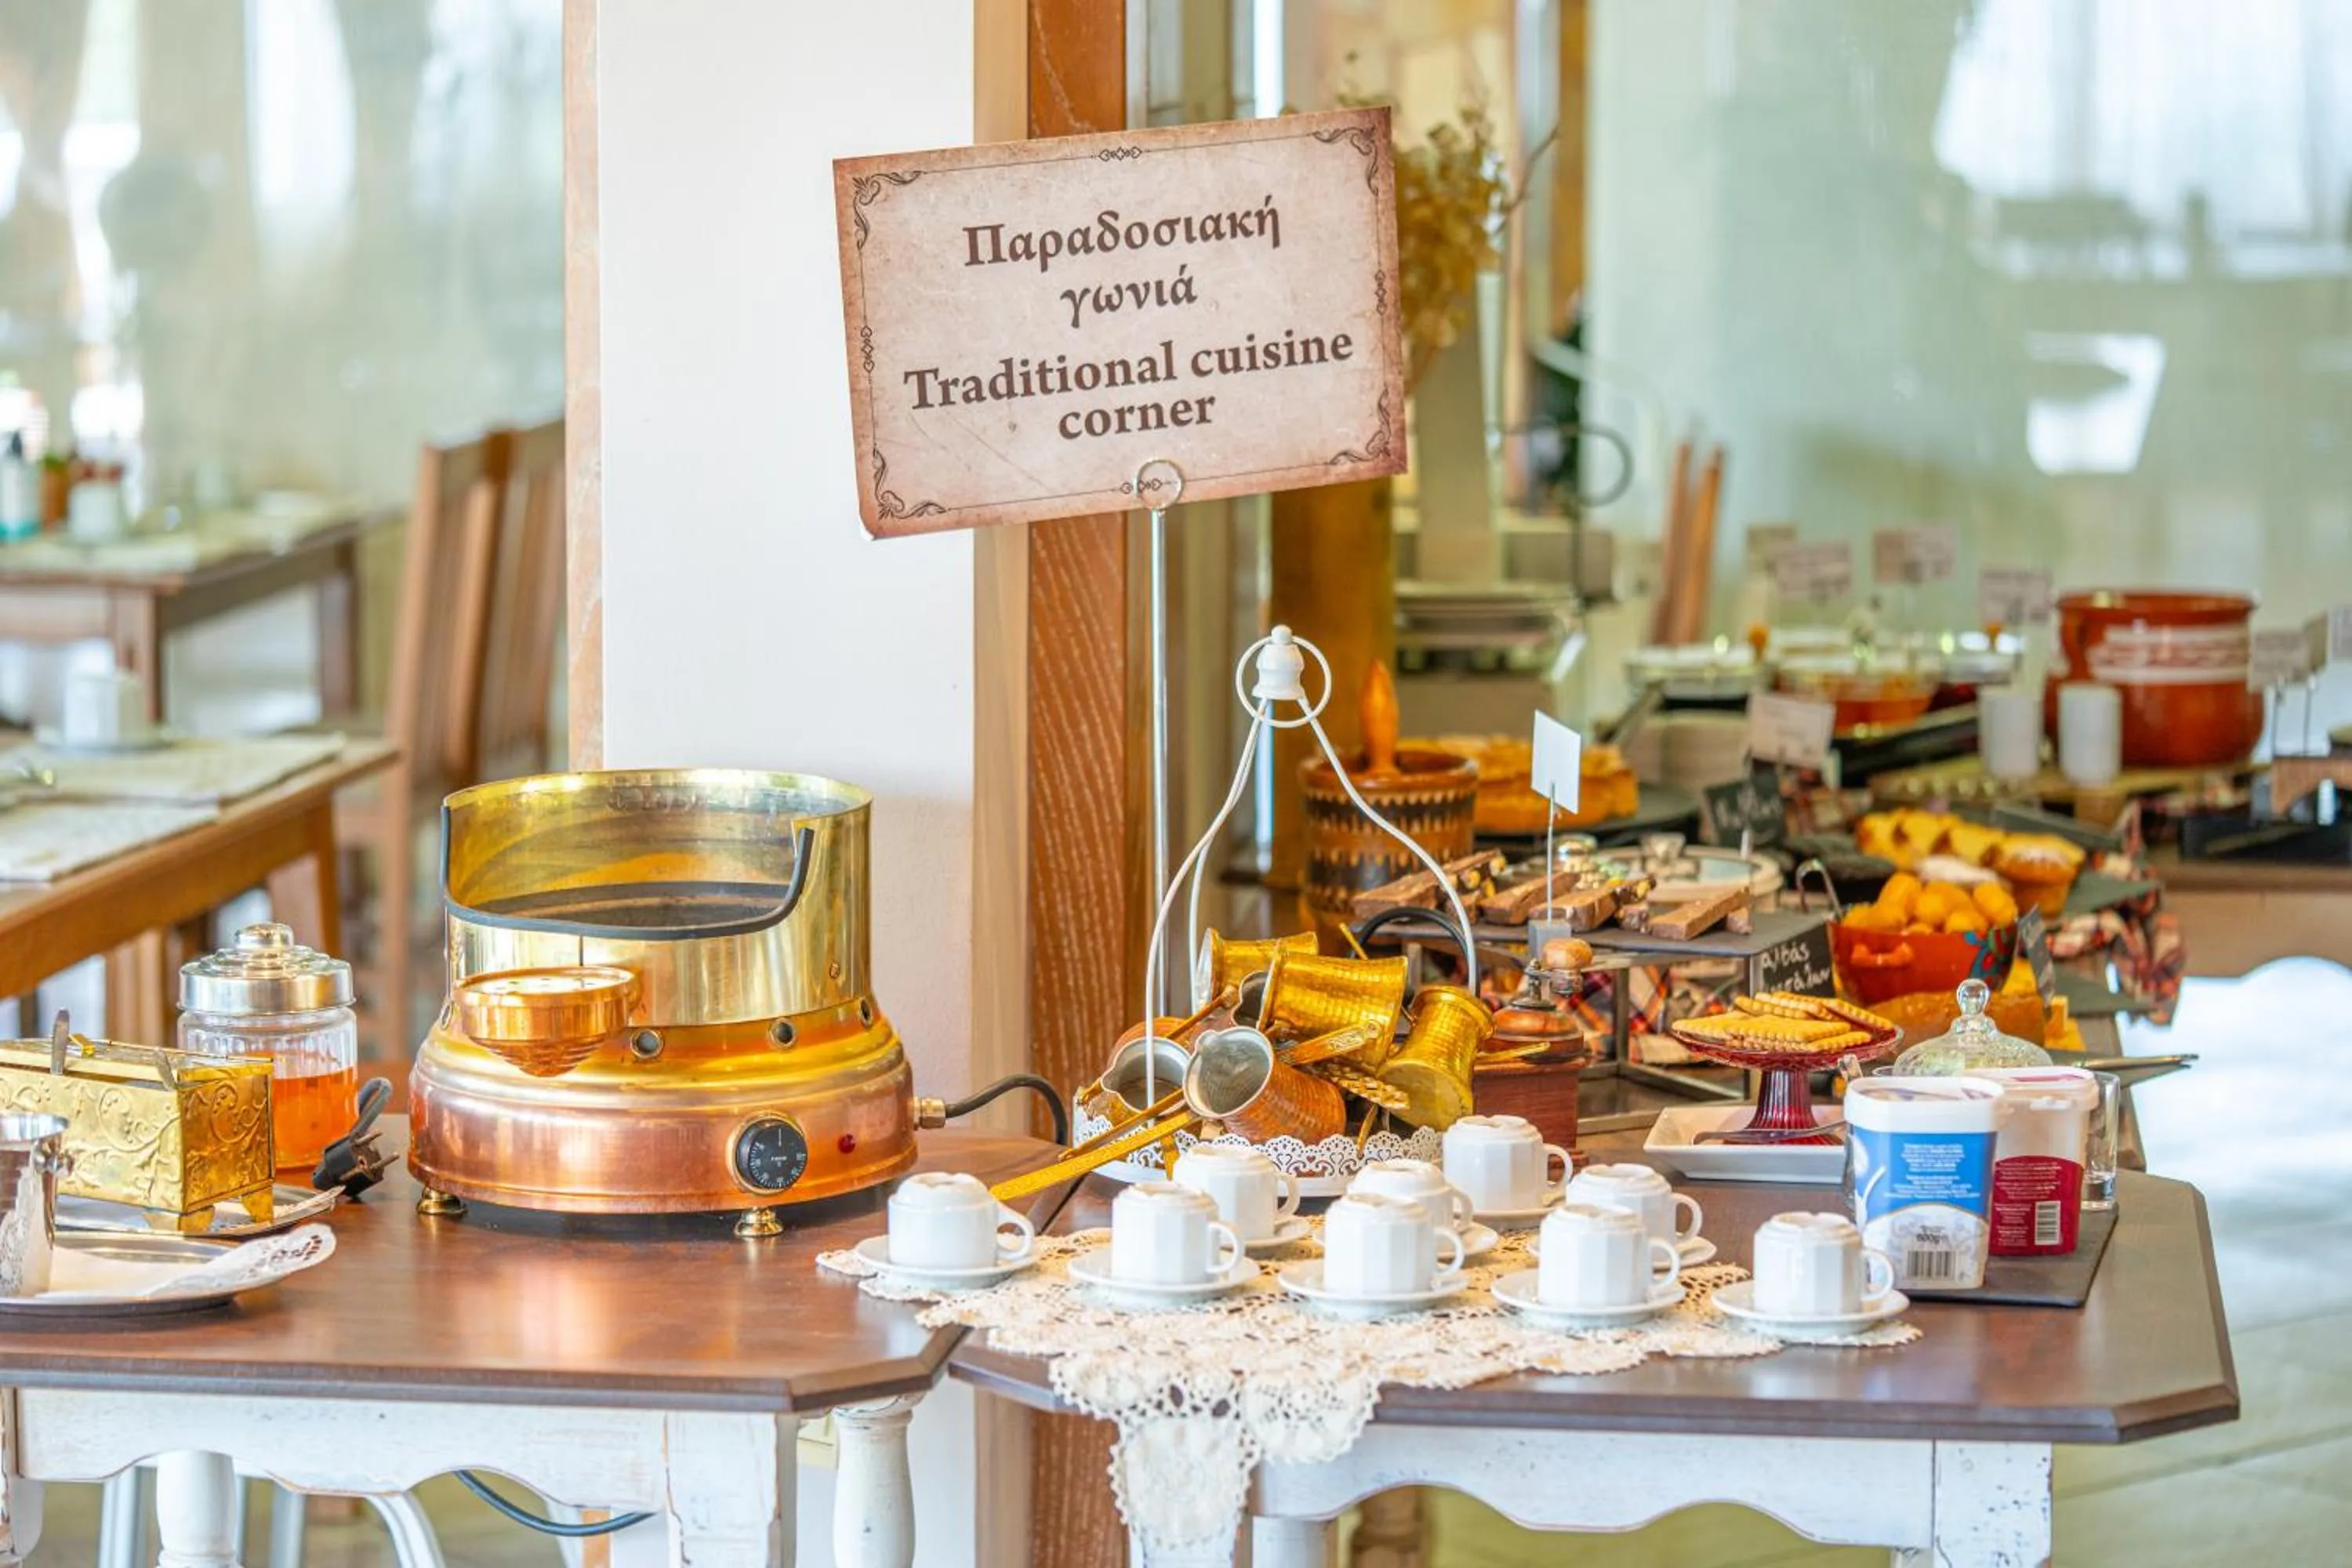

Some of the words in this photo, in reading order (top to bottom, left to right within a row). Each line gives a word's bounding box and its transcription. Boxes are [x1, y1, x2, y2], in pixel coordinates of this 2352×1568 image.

[962, 194, 1280, 273] Παραδοσιακή
[1060, 264, 1197, 328] γωνιά
[903, 340, 1177, 410] Traditional
[1191, 329, 1353, 377] cuisine
[1058, 396, 1216, 439] corner
